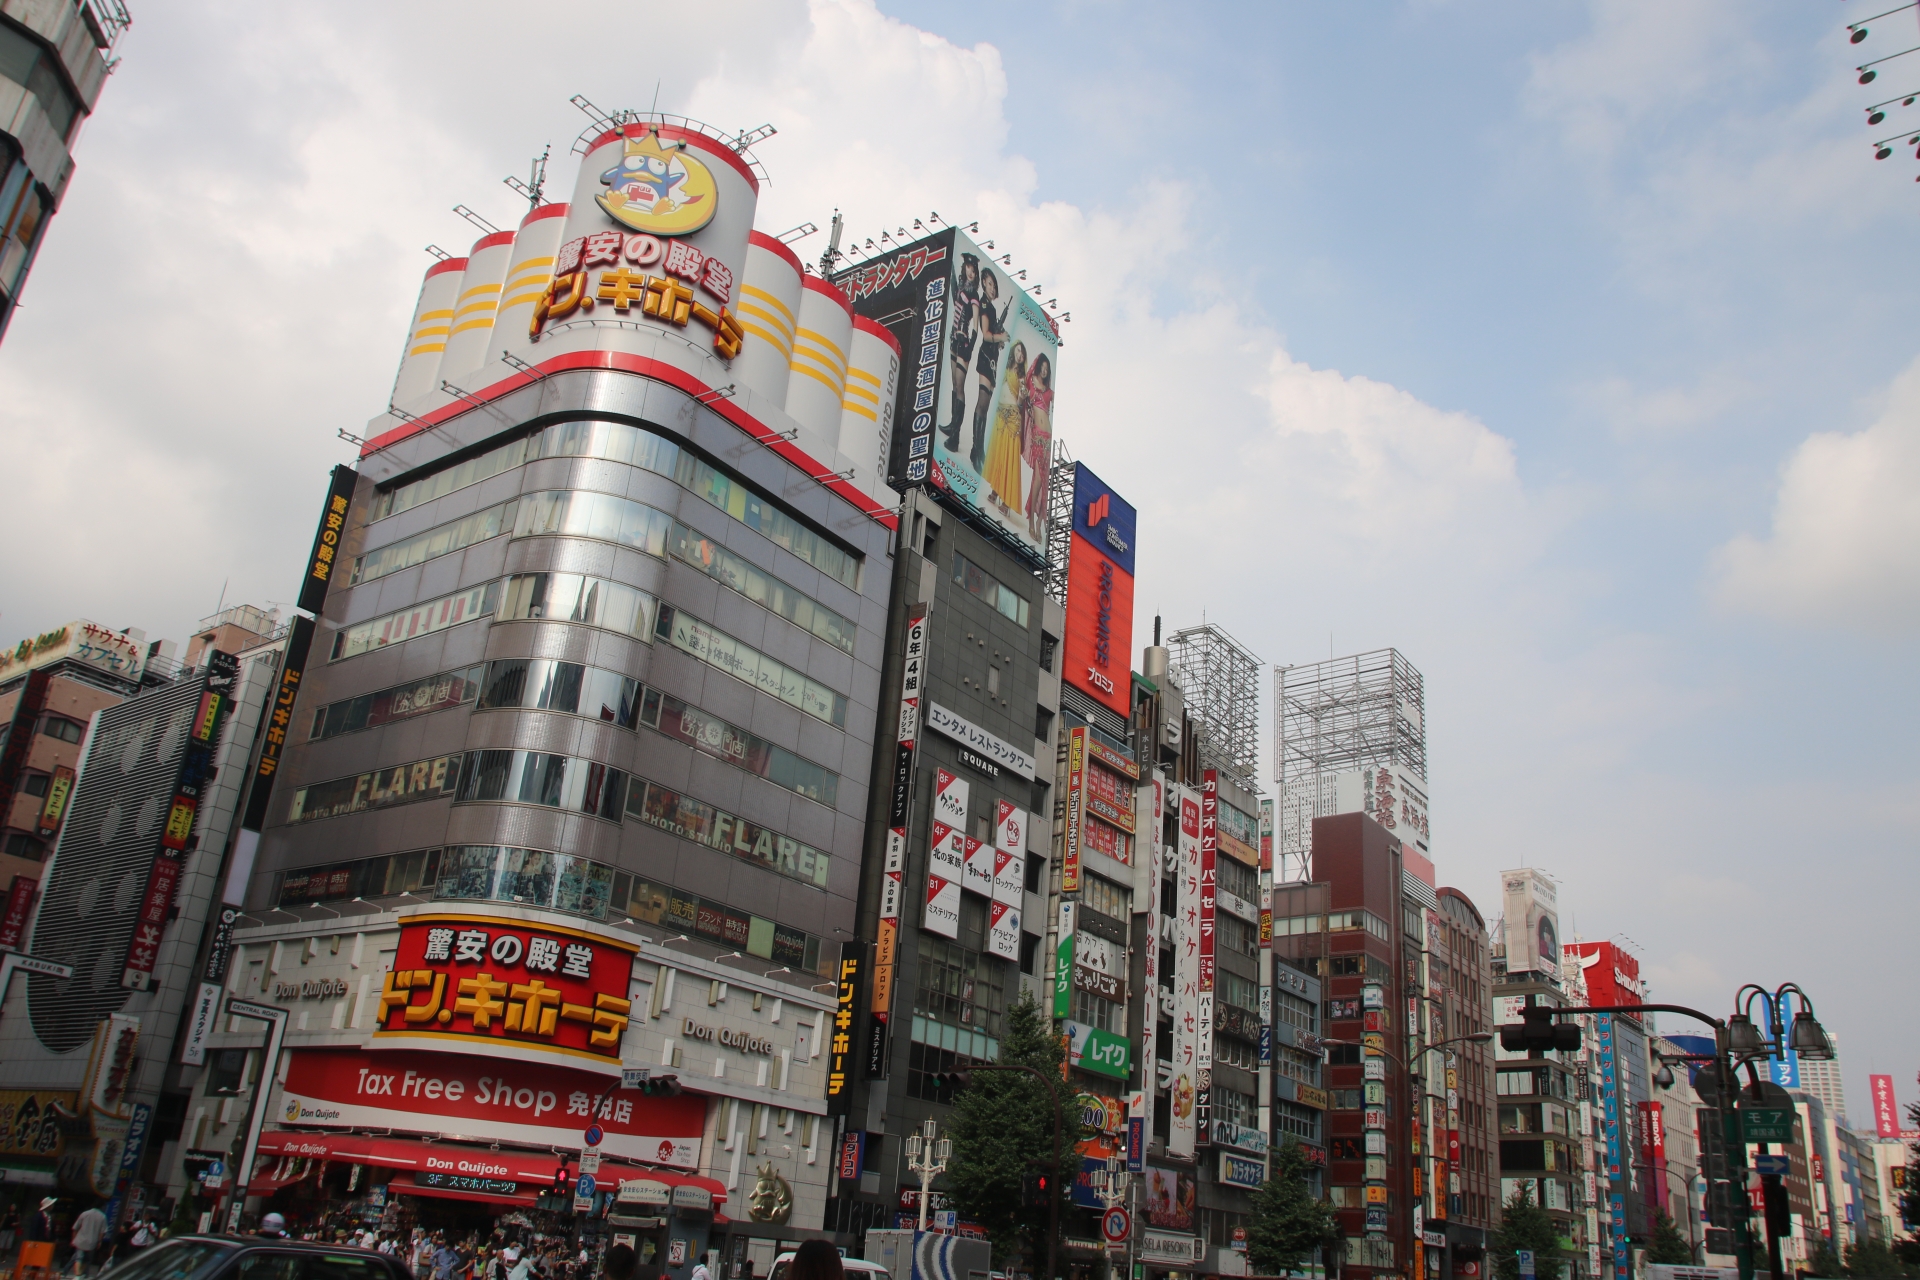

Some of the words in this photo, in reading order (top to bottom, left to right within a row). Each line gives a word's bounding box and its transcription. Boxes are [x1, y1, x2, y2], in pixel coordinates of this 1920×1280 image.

[556, 230, 735, 304] 驚安の殿堂
[1020, 308, 1056, 344] アラビアンロック
[908, 276, 946, 482] 進化型居酒屋の聖地
[939, 460, 977, 494] ザ・ロックアップ
[313, 494, 347, 580] 驚安の殿堂
[1095, 559, 1114, 668] PROMISE
[691, 624, 720, 644] namco
[78, 641, 142, 676] カプセル
[904, 626, 921, 690] 6年4組
[1088, 667, 1114, 695] プロミス
[963, 751, 999, 776] SQUARE
[1105, 750, 1126, 768] インターネット
[1140, 735, 1149, 772] 水上ビル
[353, 758, 447, 801] FLARE
[896, 752, 909, 817] ザ・ロックアップ
[939, 773, 949, 784] 8F
[1000, 803, 1009, 814] 9F
[1094, 799, 1119, 820] インターネット
[1376, 768, 1396, 829] 東海苑
[302, 808, 330, 822] PHOTO
[333, 801, 368, 816] STUDIO
[1067, 789, 1080, 859] インターネット
[1401, 797, 1429, 840] 東海苑
[643, 811, 683, 835] PHOTO
[690, 829, 732, 854] STUDIO
[714, 811, 815, 873] FLARE
[934, 825, 945, 836] 4F
[165, 848, 178, 856] 6F
[890, 837, 899, 868] 手羽一郎
[966, 839, 976, 850] 5F
[932, 847, 962, 869] 北の家族
[996, 853, 1006, 864] 6F
[310, 876, 328, 887] ブランド
[331, 872, 349, 883] 時計
[929, 879, 939, 890] B1
[995, 876, 1022, 894] ロックアップ
[149, 877, 170, 921] 居楽屋
[670, 897, 695, 920] 販売
[886, 880, 894, 913] 北の家族
[699, 910, 722, 925] ブランド
[927, 903, 958, 923] ミステリアス
[992, 905, 1002, 915] 2F
[726, 918, 748, 934] 時計
[992, 927, 1018, 944] アラビアン
[424, 927, 593, 979] 驚安の殿堂
[998, 941, 1013, 953] ロック
[878, 928, 891, 1000] アラビアンロック
[1057, 958, 1069, 992] レイク
[1207, 960, 1213, 976] 名物
[274, 982, 296, 999] Don
[301, 978, 347, 999] Quijote
[194, 998, 211, 1044] 写真スタジオ
[232, 1003, 262, 1016] CENTRAL
[263, 1010, 279, 1019] ROAD
[683, 1017, 714, 1042] Don
[719, 1025, 773, 1055] Quijote
[1200, 997, 1210, 1052] パーティー
[189, 1046, 200, 1057] 5F
[870, 1026, 881, 1071] ミステリアス
[1092, 1038, 1126, 1067] レイク
[1261, 1027, 1270, 1059] 747
[624, 1072, 648, 1081] 歌舞伎町
[357, 1068, 393, 1095] Tax
[402, 1070, 463, 1101] Free
[474, 1076, 557, 1117] Shop
[567, 1091, 633, 1124] 免税店
[1601, 1016, 1620, 1173] カラオケ&パーティー館
[1877, 1079, 1891, 1133] 東京大飯店
[301, 1108, 314, 1118] Don
[316, 1108, 340, 1120] Quijote
[1198, 1093, 1209, 1130] ダーツ
[1748, 1112, 1783, 1123] モア
[124, 1108, 148, 1166] カラオケ
[1132, 1122, 1140, 1159] PROMISE
[1652, 1110, 1661, 1147] SHIDAX
[1750, 1128, 1784, 1137] 靖国通り
[284, 1142, 296, 1152] Don
[297, 1143, 327, 1155] Quijote
[427, 1157, 453, 1169] Don
[458, 1161, 508, 1175] Quijote
[1232, 1161, 1256, 1182] カラオケ
[580, 1179, 588, 1193] P
[901, 1192, 914, 1204] 4F
[1163, 1240, 1191, 1255] RESORTS
[1614, 1202, 1627, 1275] カラオケ館
[1521, 1252, 1529, 1264] P
